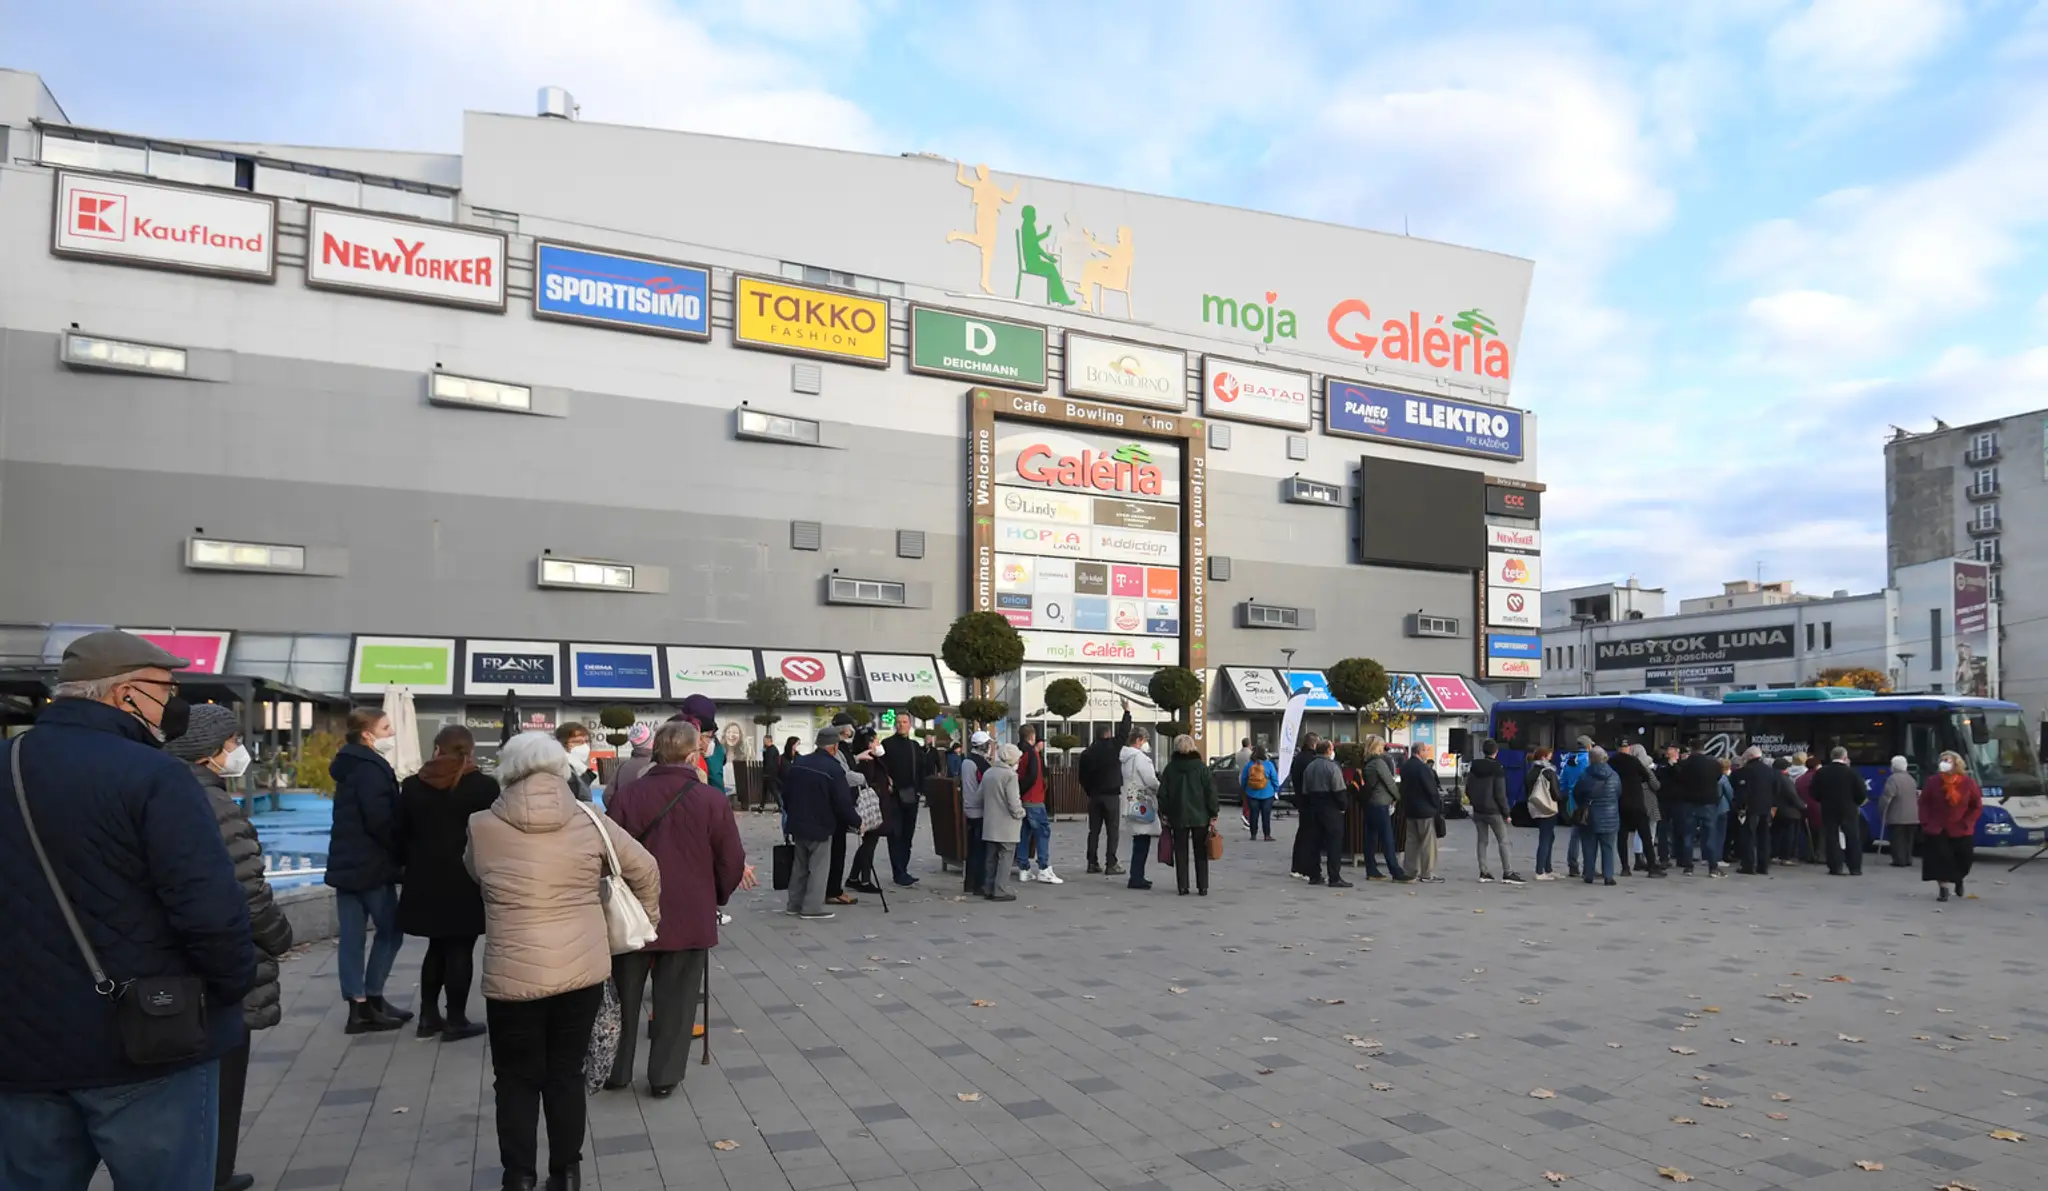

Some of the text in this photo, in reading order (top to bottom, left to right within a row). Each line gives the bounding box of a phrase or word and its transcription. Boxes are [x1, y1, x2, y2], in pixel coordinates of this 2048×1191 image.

[133, 215, 262, 253] Kaufland
[546, 274, 700, 321] SPORTISIMO
[771, 325, 858, 347] FASHION
[965, 320, 996, 356] D
[1202, 290, 1509, 380] moja Galéria
[943, 356, 1018, 377] DEICHMANN
[1086, 365, 1170, 393] BONGIORNO
[1013, 397, 1173, 431] Cafe Bowling Kino
[1344, 401, 1388, 419] PLANEO
[1405, 399, 1509, 438] ELEKTRO
[1466, 435, 1478, 446] PRE
[977, 429, 989, 505] Welcome
[1016, 444, 1162, 495] Galéria
[1504, 494, 1525, 506] CCC
[1006, 527, 1081, 544] HOPLA
[980, 546, 990, 612] kommen
[1192, 537, 1204, 637] nakupovanie
[1047, 641, 1135, 659] moja Galéria
[1600, 629, 1787, 658] NÁBYTOK LUNA
[482, 656, 545, 671] FRANK
[1649, 655, 1662, 663] na
[870, 671, 915, 683] BENU
[1118, 674, 1149, 695] Witam
[787, 685, 842, 697] artinus
